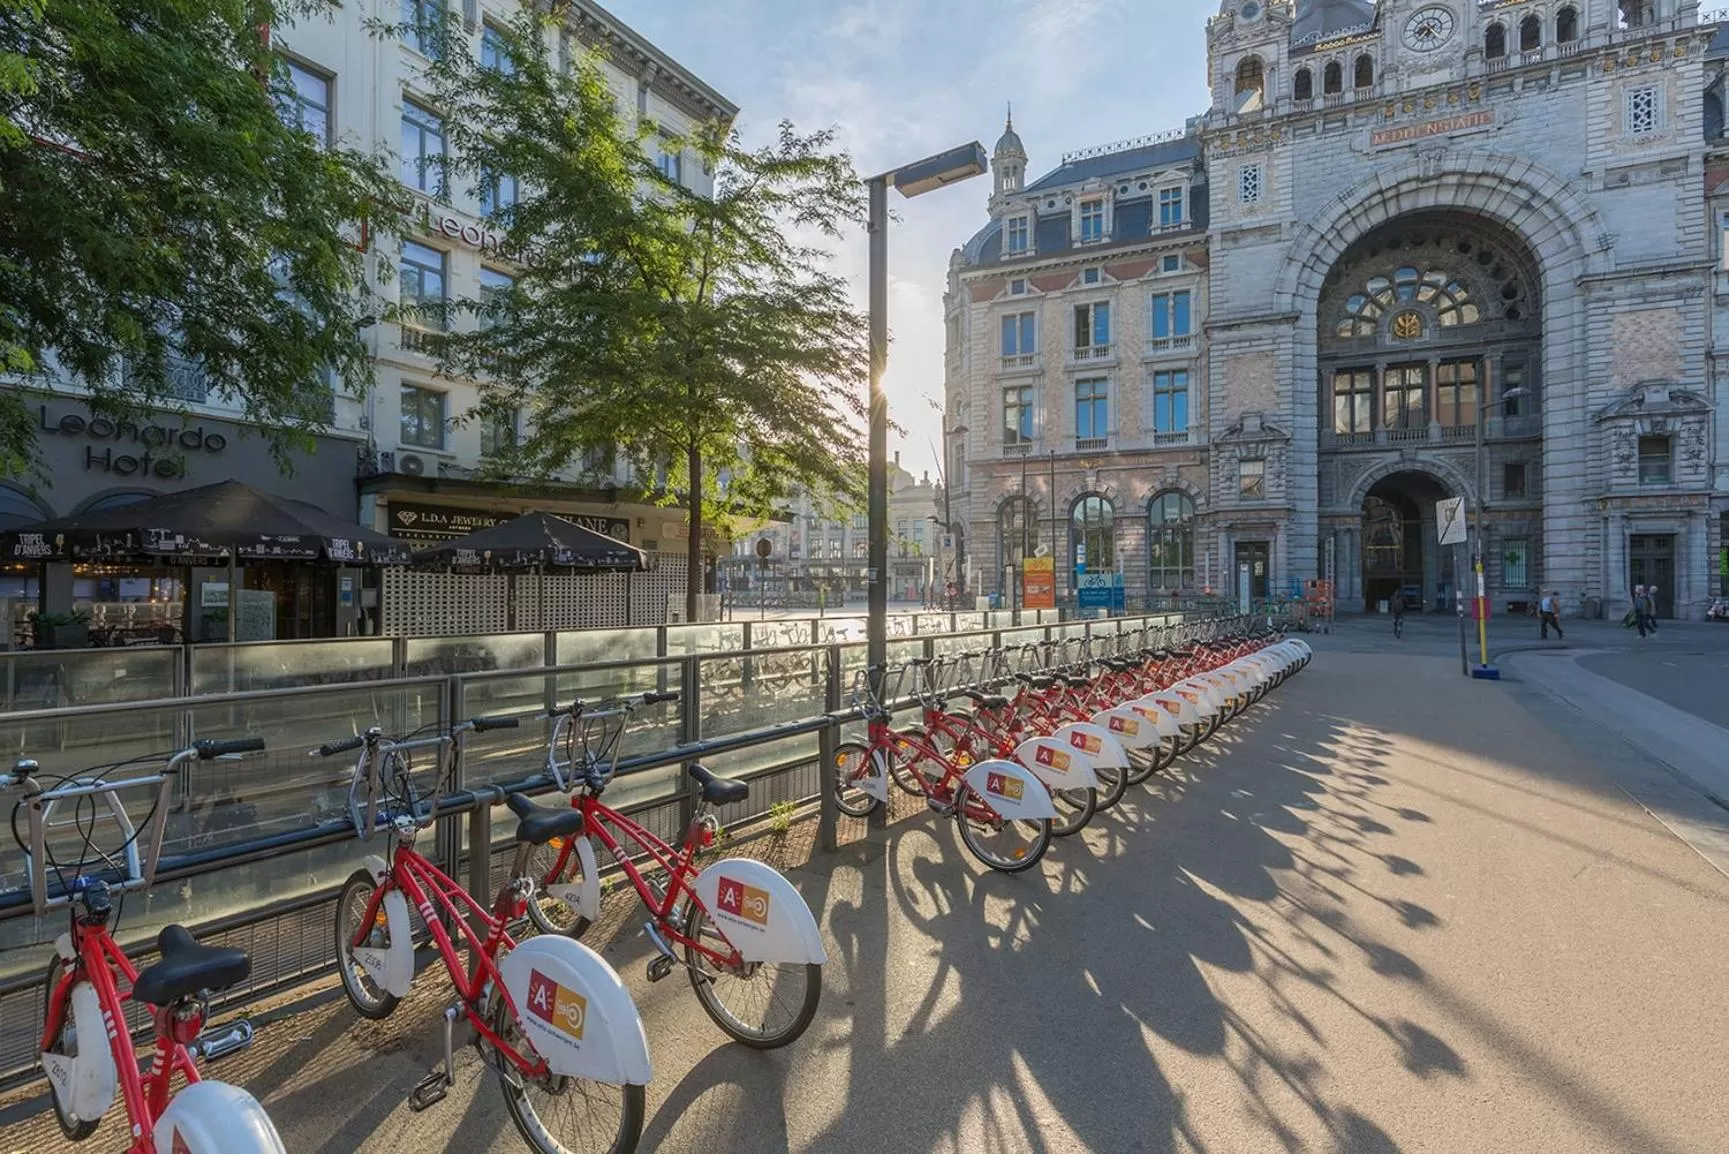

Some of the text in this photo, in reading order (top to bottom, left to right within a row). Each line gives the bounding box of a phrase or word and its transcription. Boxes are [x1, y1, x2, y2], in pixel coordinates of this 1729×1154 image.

[40, 405, 227, 452] Leonardo
[86, 445, 186, 479] Hotel
[723, 887, 736, 907] A
[534, 984, 548, 1011] A
